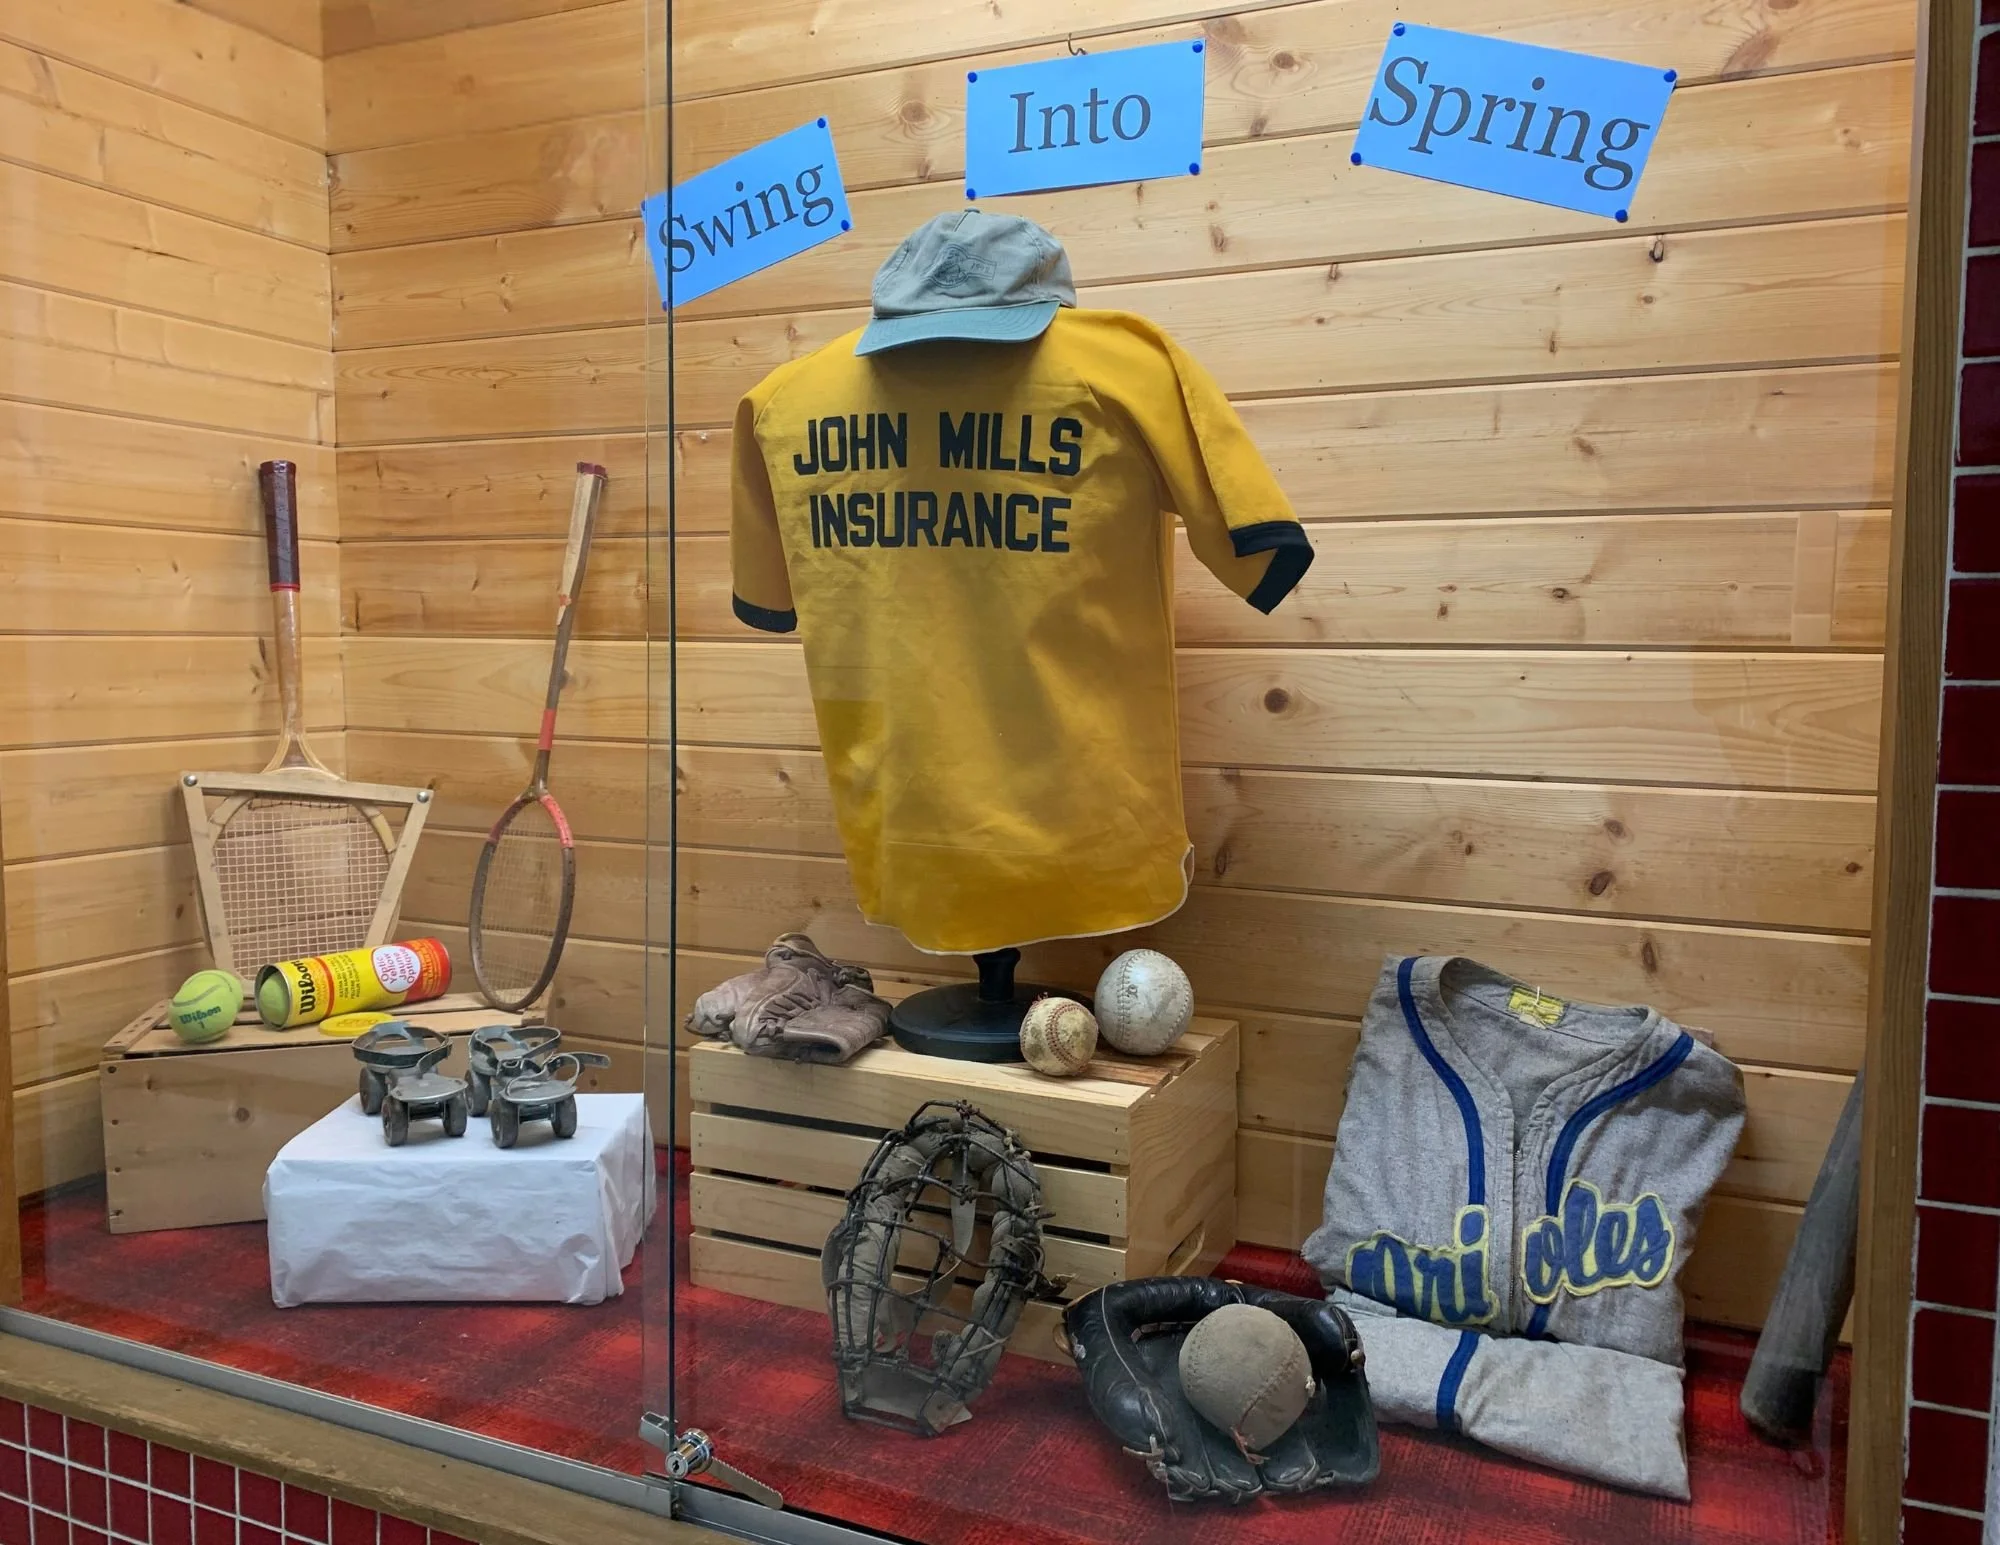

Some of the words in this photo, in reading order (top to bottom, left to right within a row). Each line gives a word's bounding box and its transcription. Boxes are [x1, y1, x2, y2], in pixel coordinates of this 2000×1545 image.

[1007, 87, 1152, 154] Into
[1368, 56, 1651, 191] Spring
[657, 164, 836, 274] Swing
[793, 412, 907, 476] JOHN
[939, 411, 1083, 476] MILLS
[809, 491, 1072, 553] INSURANCE
[291, 960, 315, 1015] Wilson
[377, 956, 390, 982] Optic
[384, 953, 397, 984] Yellow
[393, 952, 407, 981] Jaune
[179, 1005, 221, 1024] Wilson
